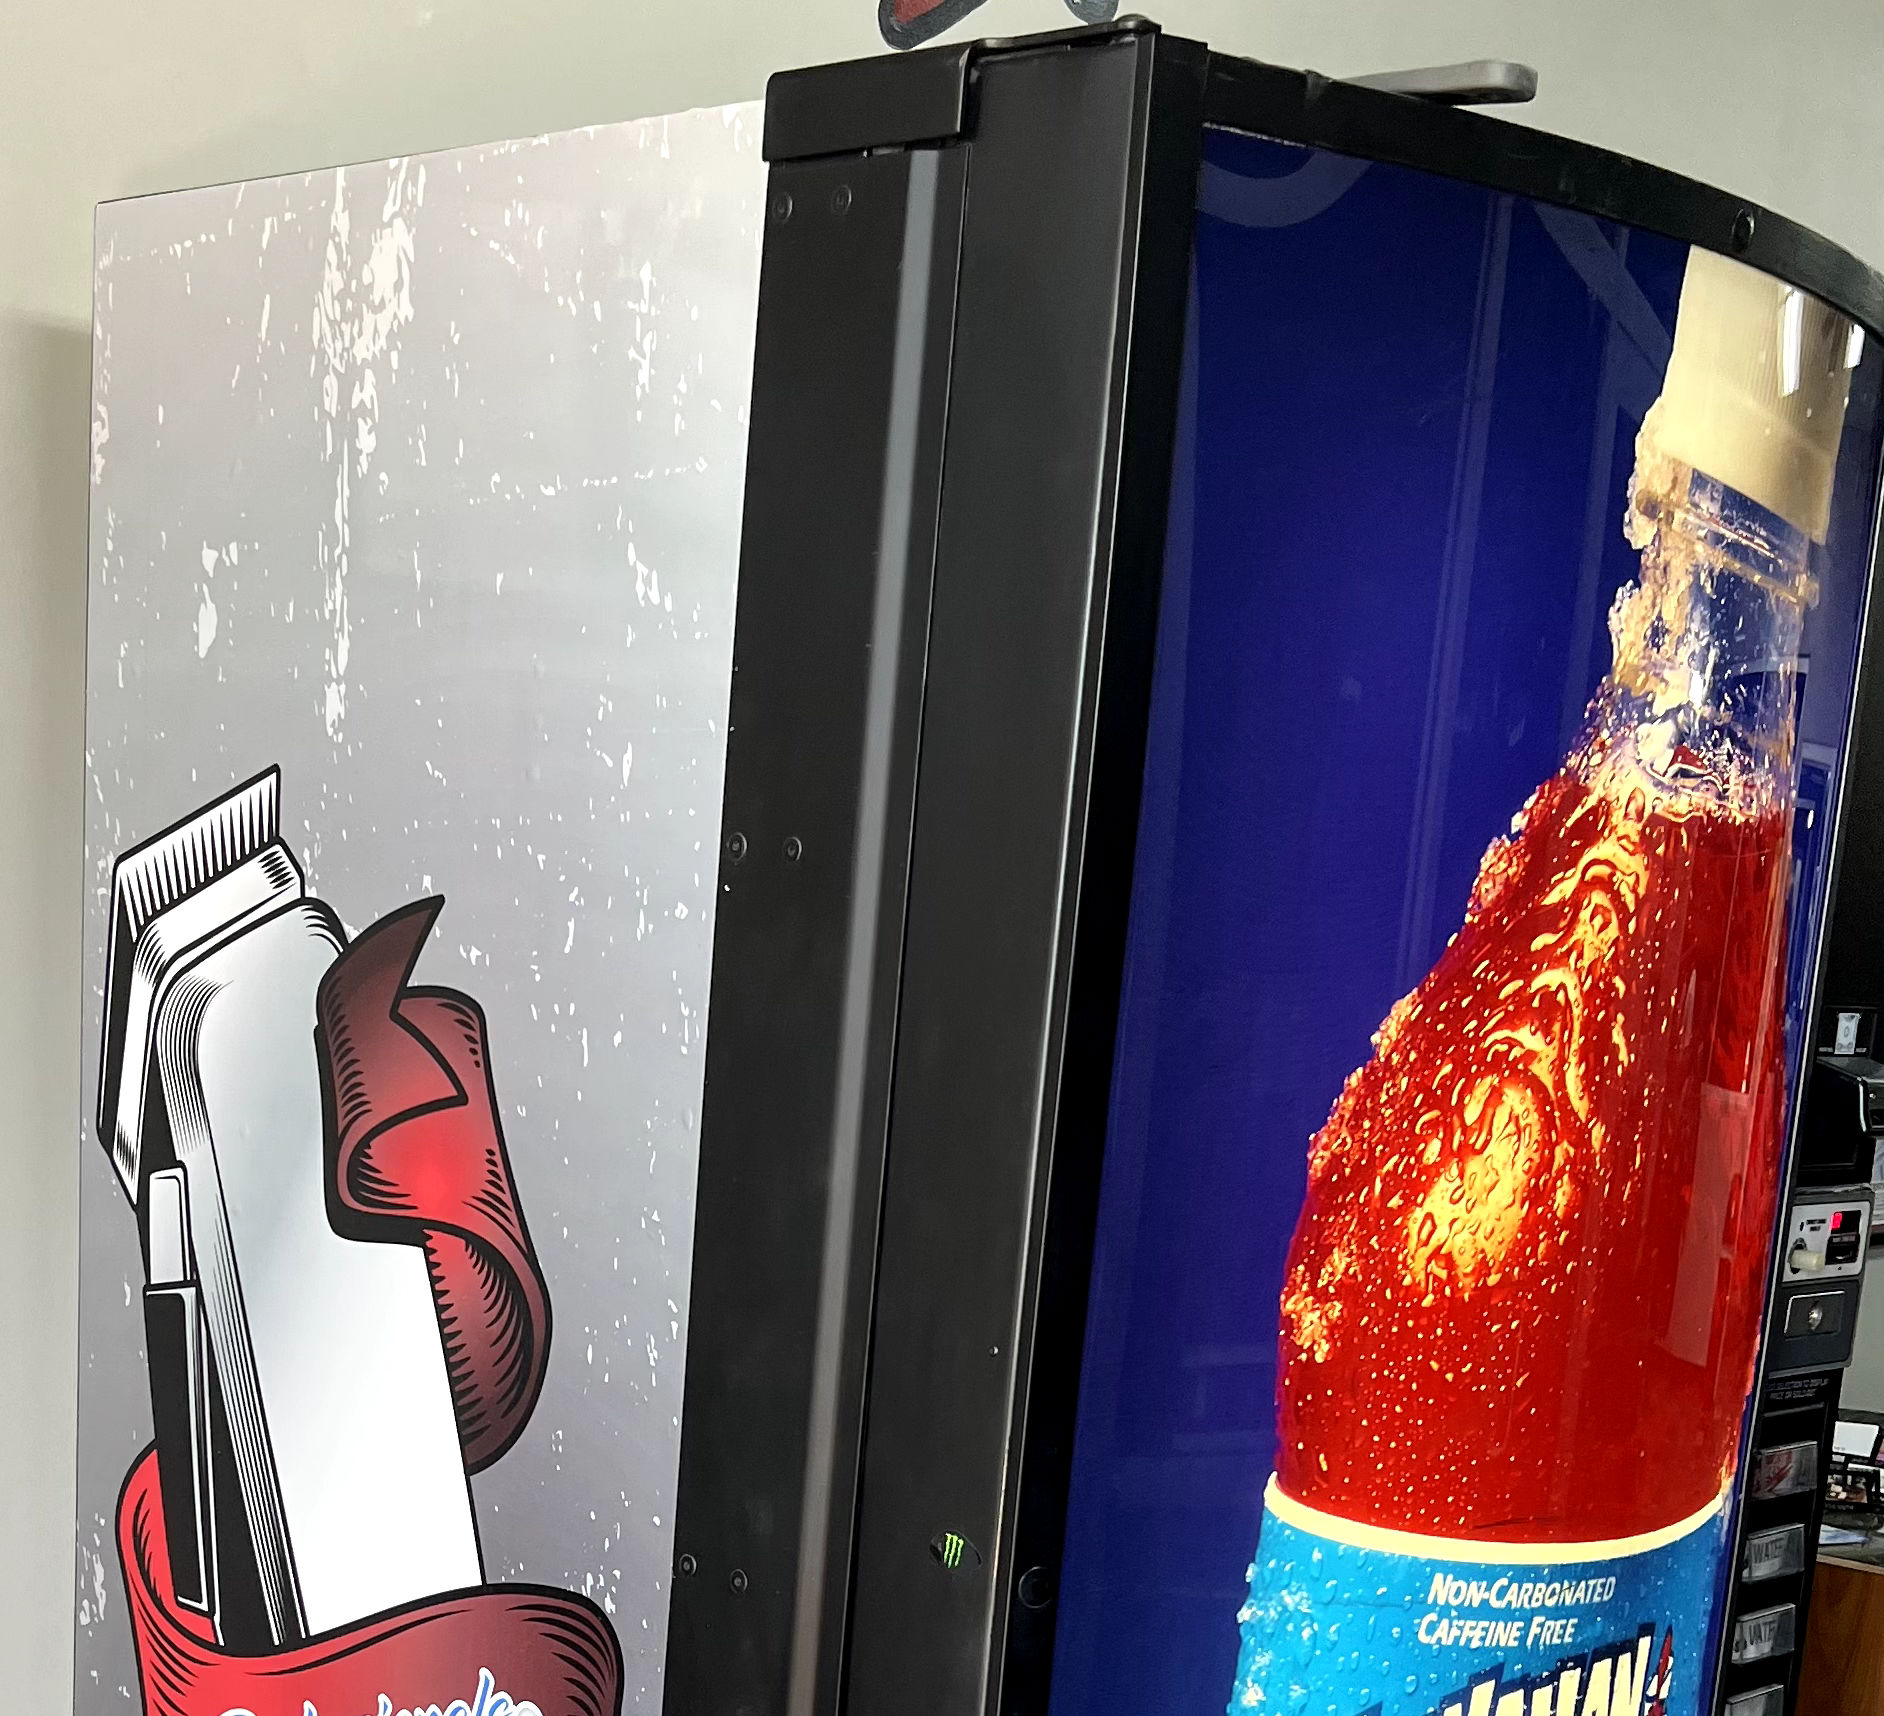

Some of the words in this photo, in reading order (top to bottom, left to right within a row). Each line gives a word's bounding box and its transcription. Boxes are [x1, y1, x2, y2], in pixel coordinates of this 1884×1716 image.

[1428, 1573, 1615, 1609] NON-CARBONATED
[1418, 1613, 1523, 1647] CAFFEINE
[1526, 1616, 1578, 1646] FREE
